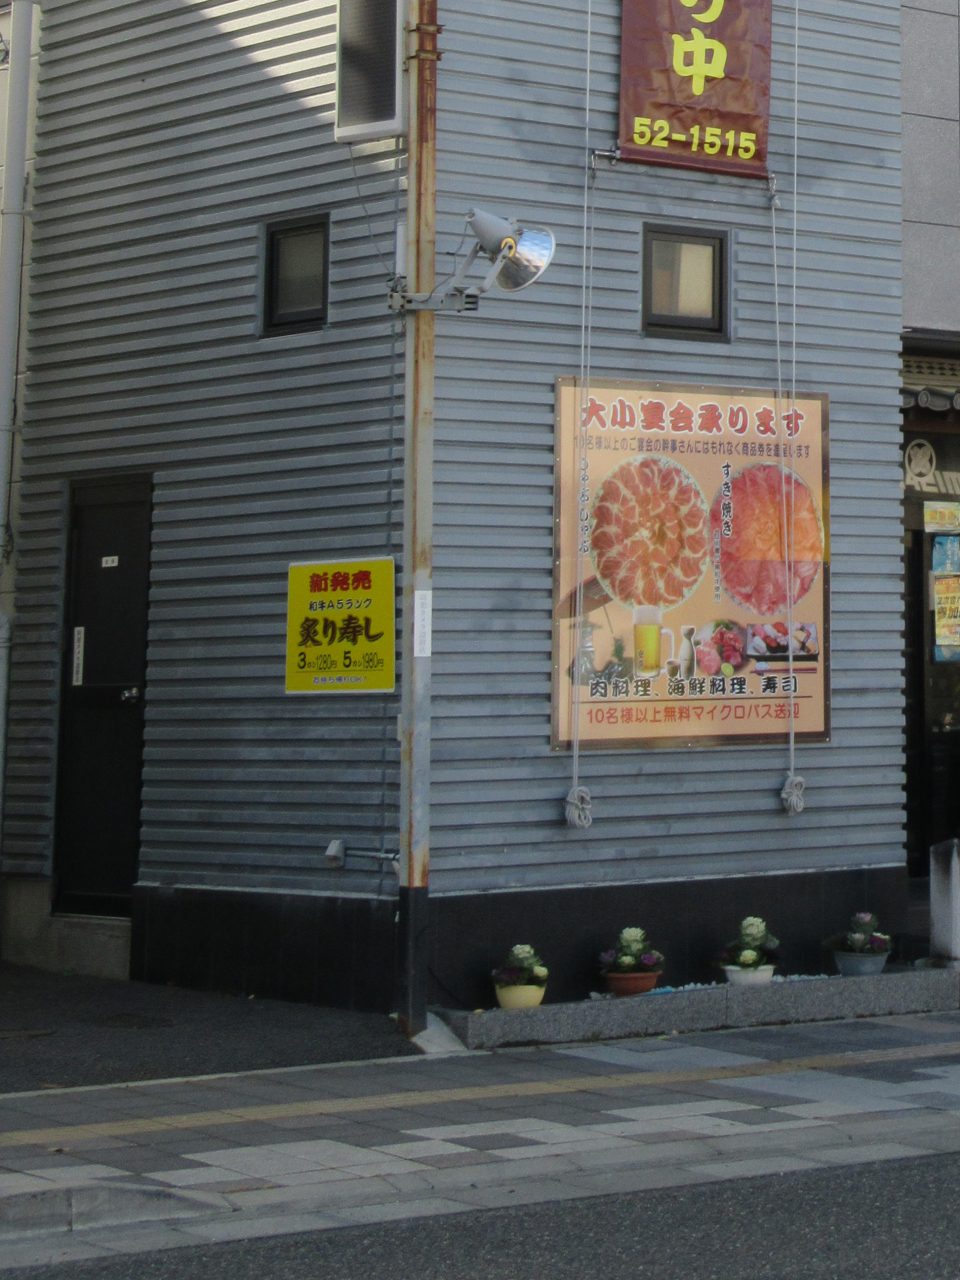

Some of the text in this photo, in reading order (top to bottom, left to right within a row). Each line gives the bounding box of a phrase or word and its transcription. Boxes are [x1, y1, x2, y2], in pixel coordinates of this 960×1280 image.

[632, 115, 758, 160] 52-1515
[581, 397, 806, 437] 大小宴会承ります
[721, 460, 734, 538] すき焼き
[309, 570, 372, 592] 新発売
[297, 614, 385, 647] 炙り寿し
